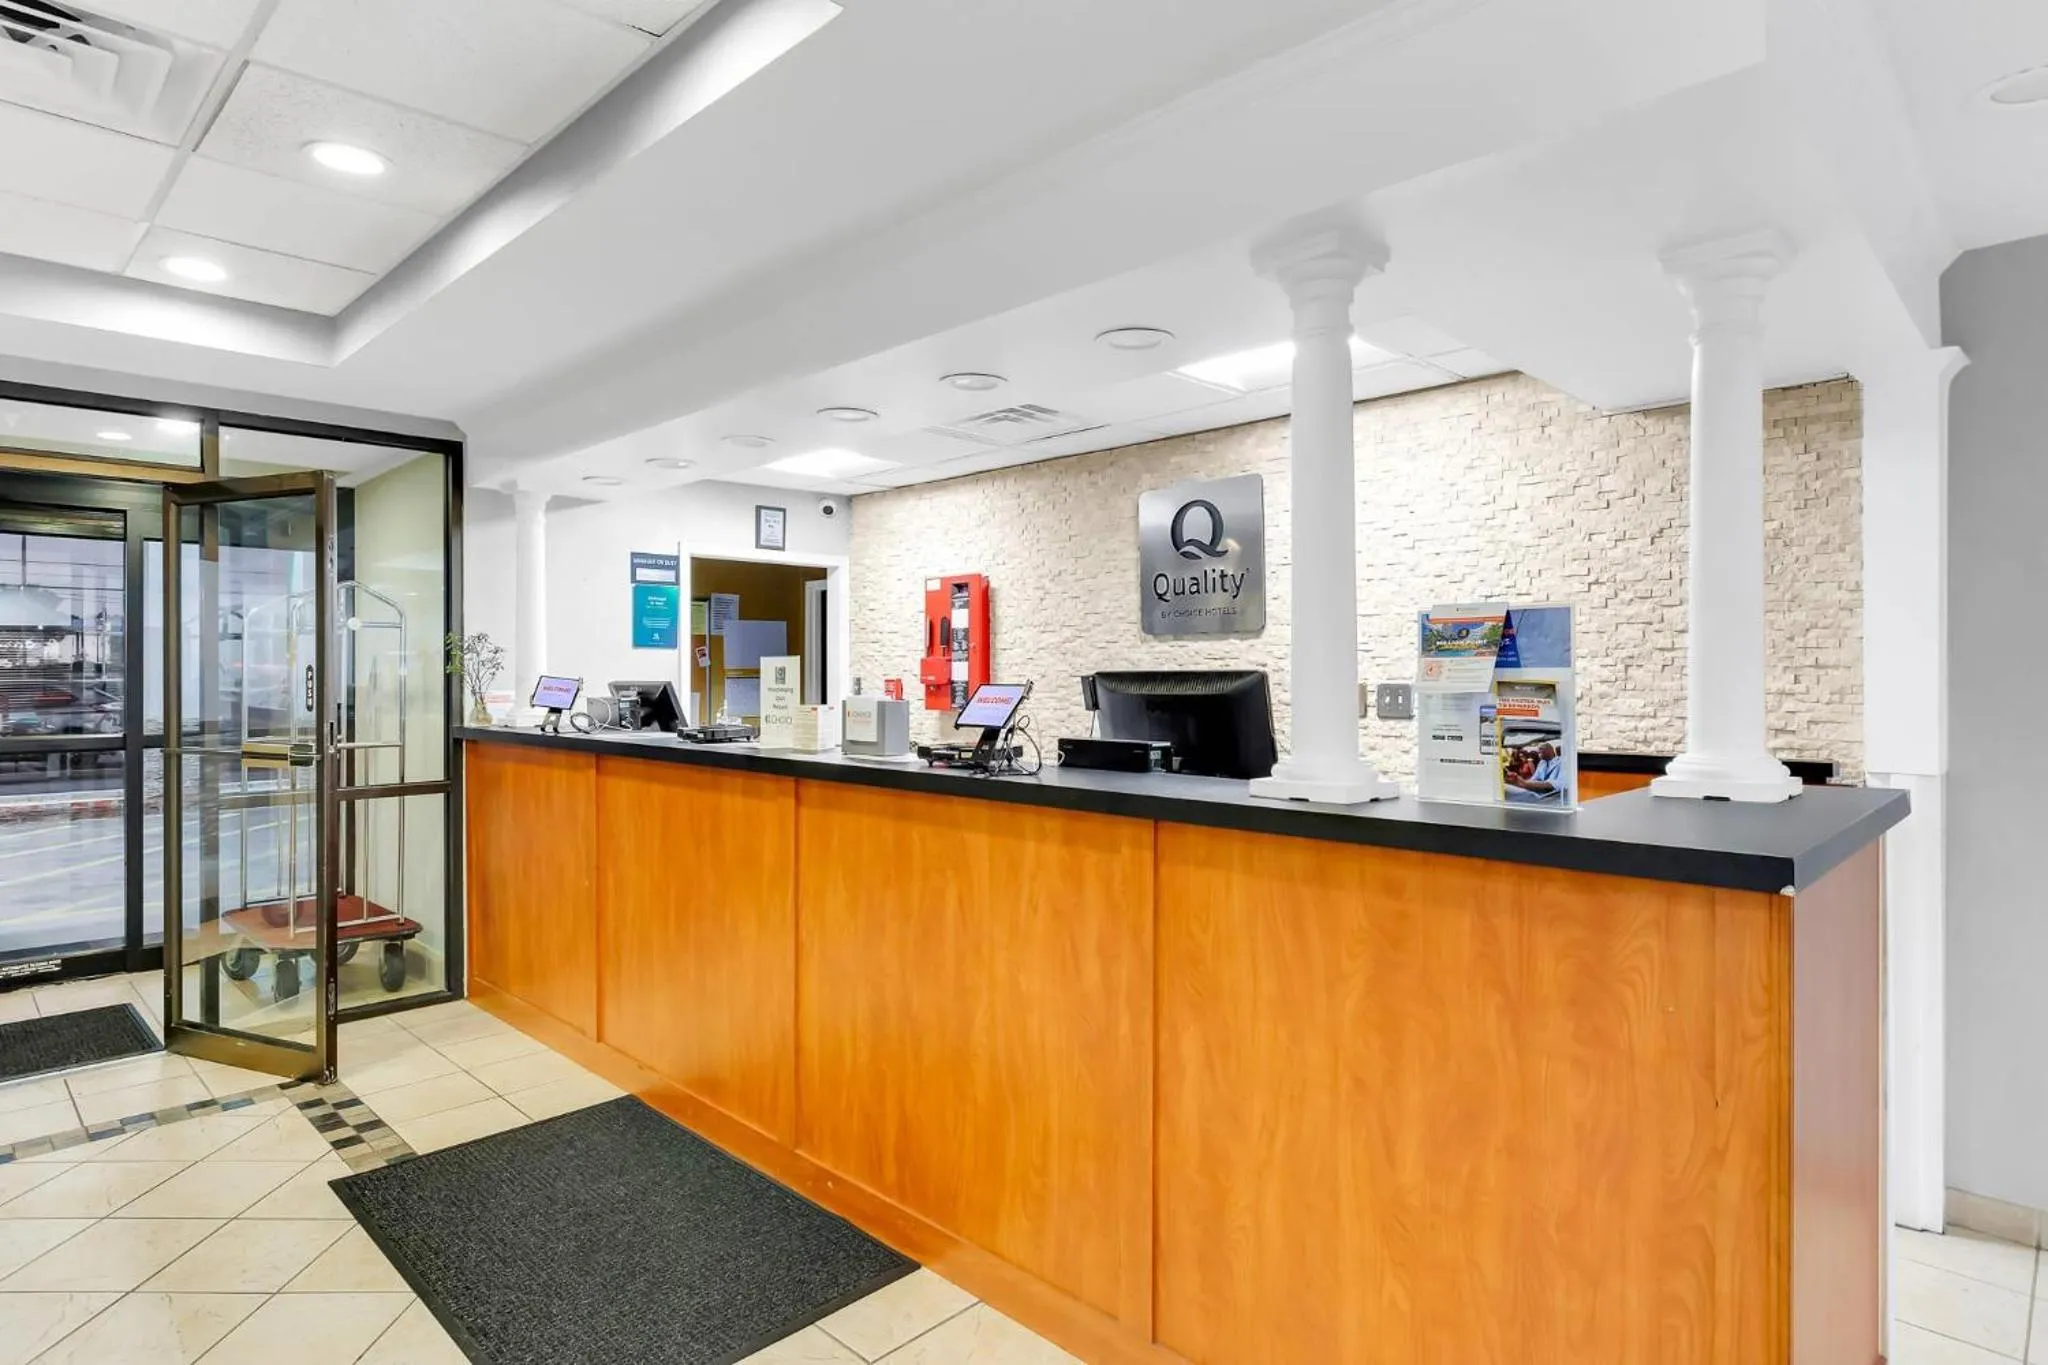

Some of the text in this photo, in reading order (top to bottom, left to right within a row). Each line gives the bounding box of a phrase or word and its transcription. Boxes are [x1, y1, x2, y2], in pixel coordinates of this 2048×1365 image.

[1171, 499, 1229, 560] Q
[1153, 568, 1245, 602] Quality
[1161, 607, 1238, 619] BY CHOICE HOTELS
